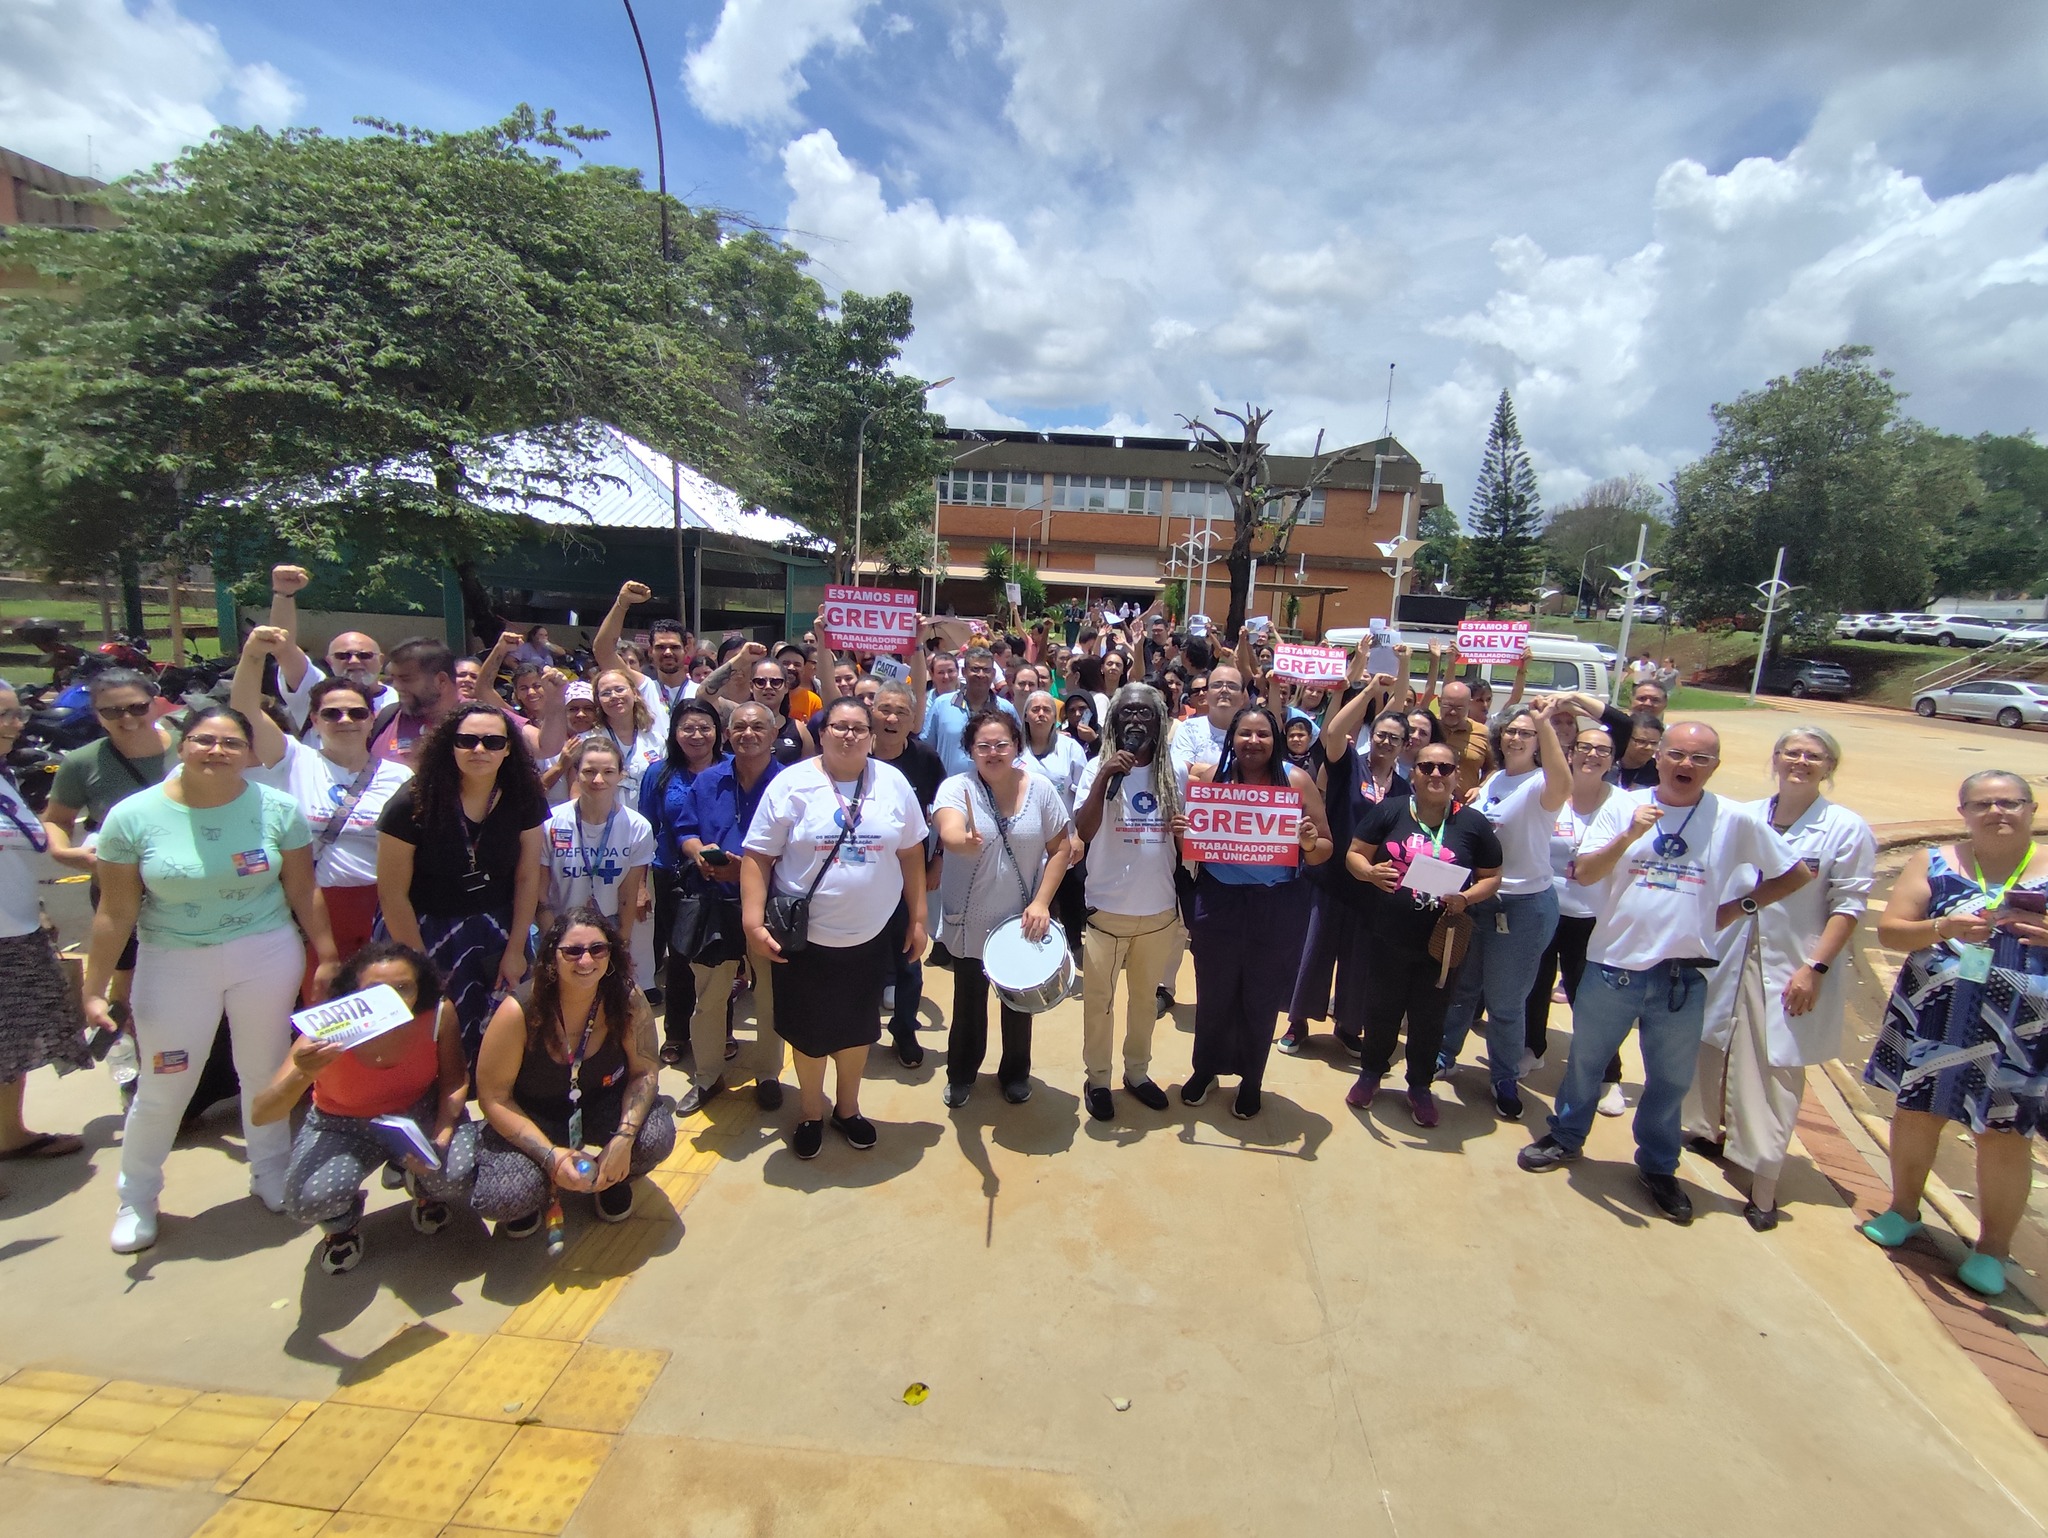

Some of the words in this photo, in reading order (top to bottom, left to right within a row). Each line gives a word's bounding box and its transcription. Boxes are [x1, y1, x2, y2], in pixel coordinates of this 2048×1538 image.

[828, 588, 891, 603] ESTAMOS
[894, 593, 915, 605] EM
[827, 606, 914, 631] GREVE
[1460, 623, 1510, 631] ESTAMOS
[1511, 623, 1528, 631] EM
[831, 633, 909, 645] TRABALHADORES
[841, 641, 854, 649] DA
[856, 642, 898, 651] UNICAMP
[1458, 634, 1527, 649] GREVE
[1277, 645, 1327, 657] ESTAMOS
[1328, 650, 1345, 659] EM
[875, 660, 898, 678] CARTA
[1275, 657, 1343, 676] GREVE
[1190, 786, 1270, 803] ESTAMOS
[1274, 791, 1299, 804] EM
[1188, 808, 1298, 837] GREVE
[1191, 841, 1289, 854] TRABALHADORES
[1204, 851, 1220, 860] DA
[1222, 852, 1275, 862] UNICAMP
[303, 997, 374, 1032] CARTA
